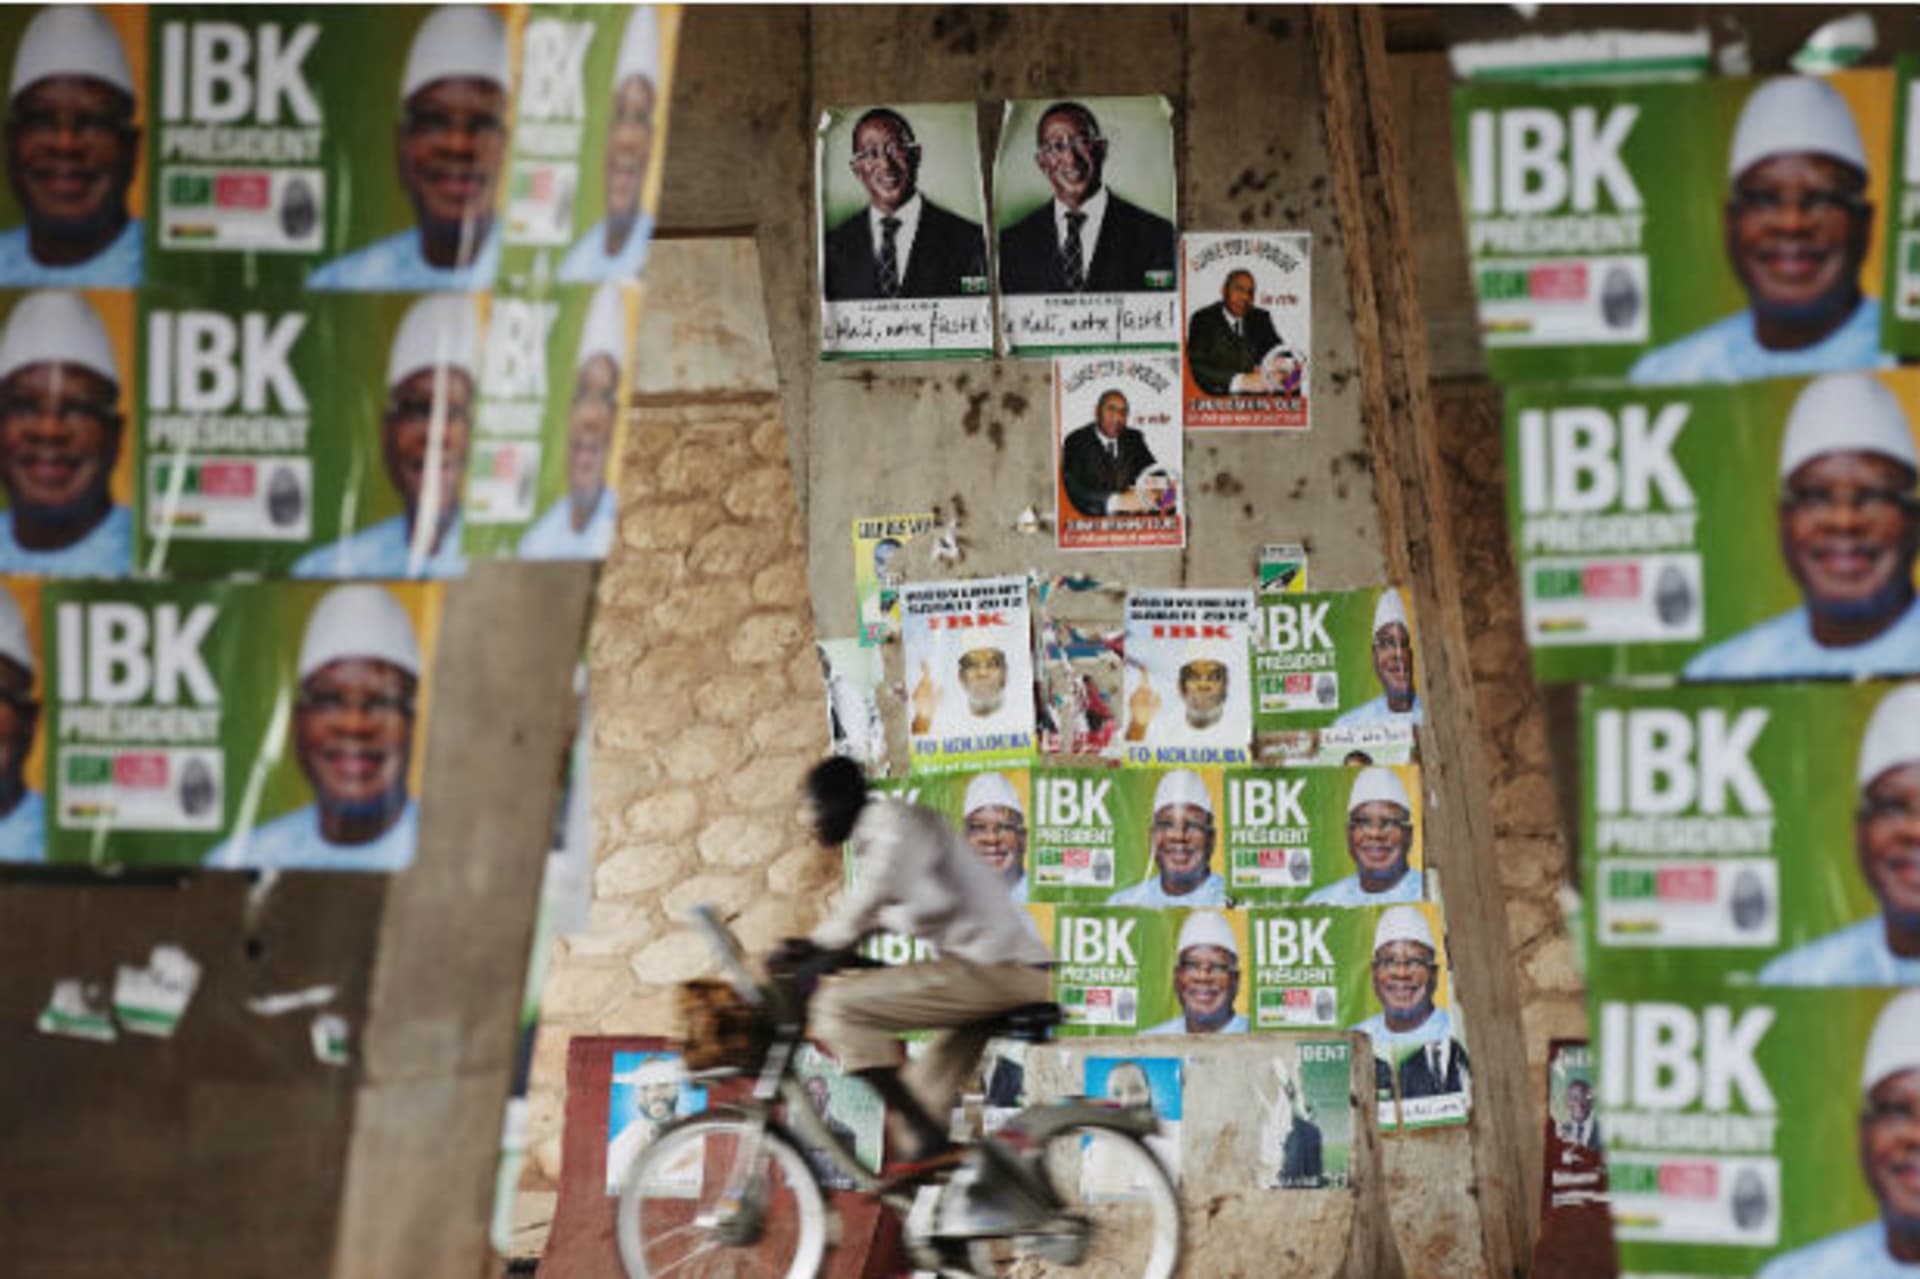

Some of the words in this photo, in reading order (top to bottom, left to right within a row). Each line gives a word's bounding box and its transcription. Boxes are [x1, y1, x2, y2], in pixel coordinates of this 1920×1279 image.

[161, 23, 321, 123] IBK
[1470, 105, 1644, 214] IBK
[146, 311, 308, 412] IBK
[1518, 404, 1695, 513] IBK
[56, 602, 220, 703] IBK
[928, 612, 1006, 630] IBK
[1152, 624, 1233, 639] IBK
[1256, 602, 1334, 651] IBK
[1595, 709, 1774, 815] IBK
[1036, 778, 1112, 825] IBK
[1230, 778, 1308, 826] IBK
[1059, 917, 1137, 965] IBK
[1255, 918, 1335, 965] IBK
[1600, 1003, 1776, 1111] IBK
